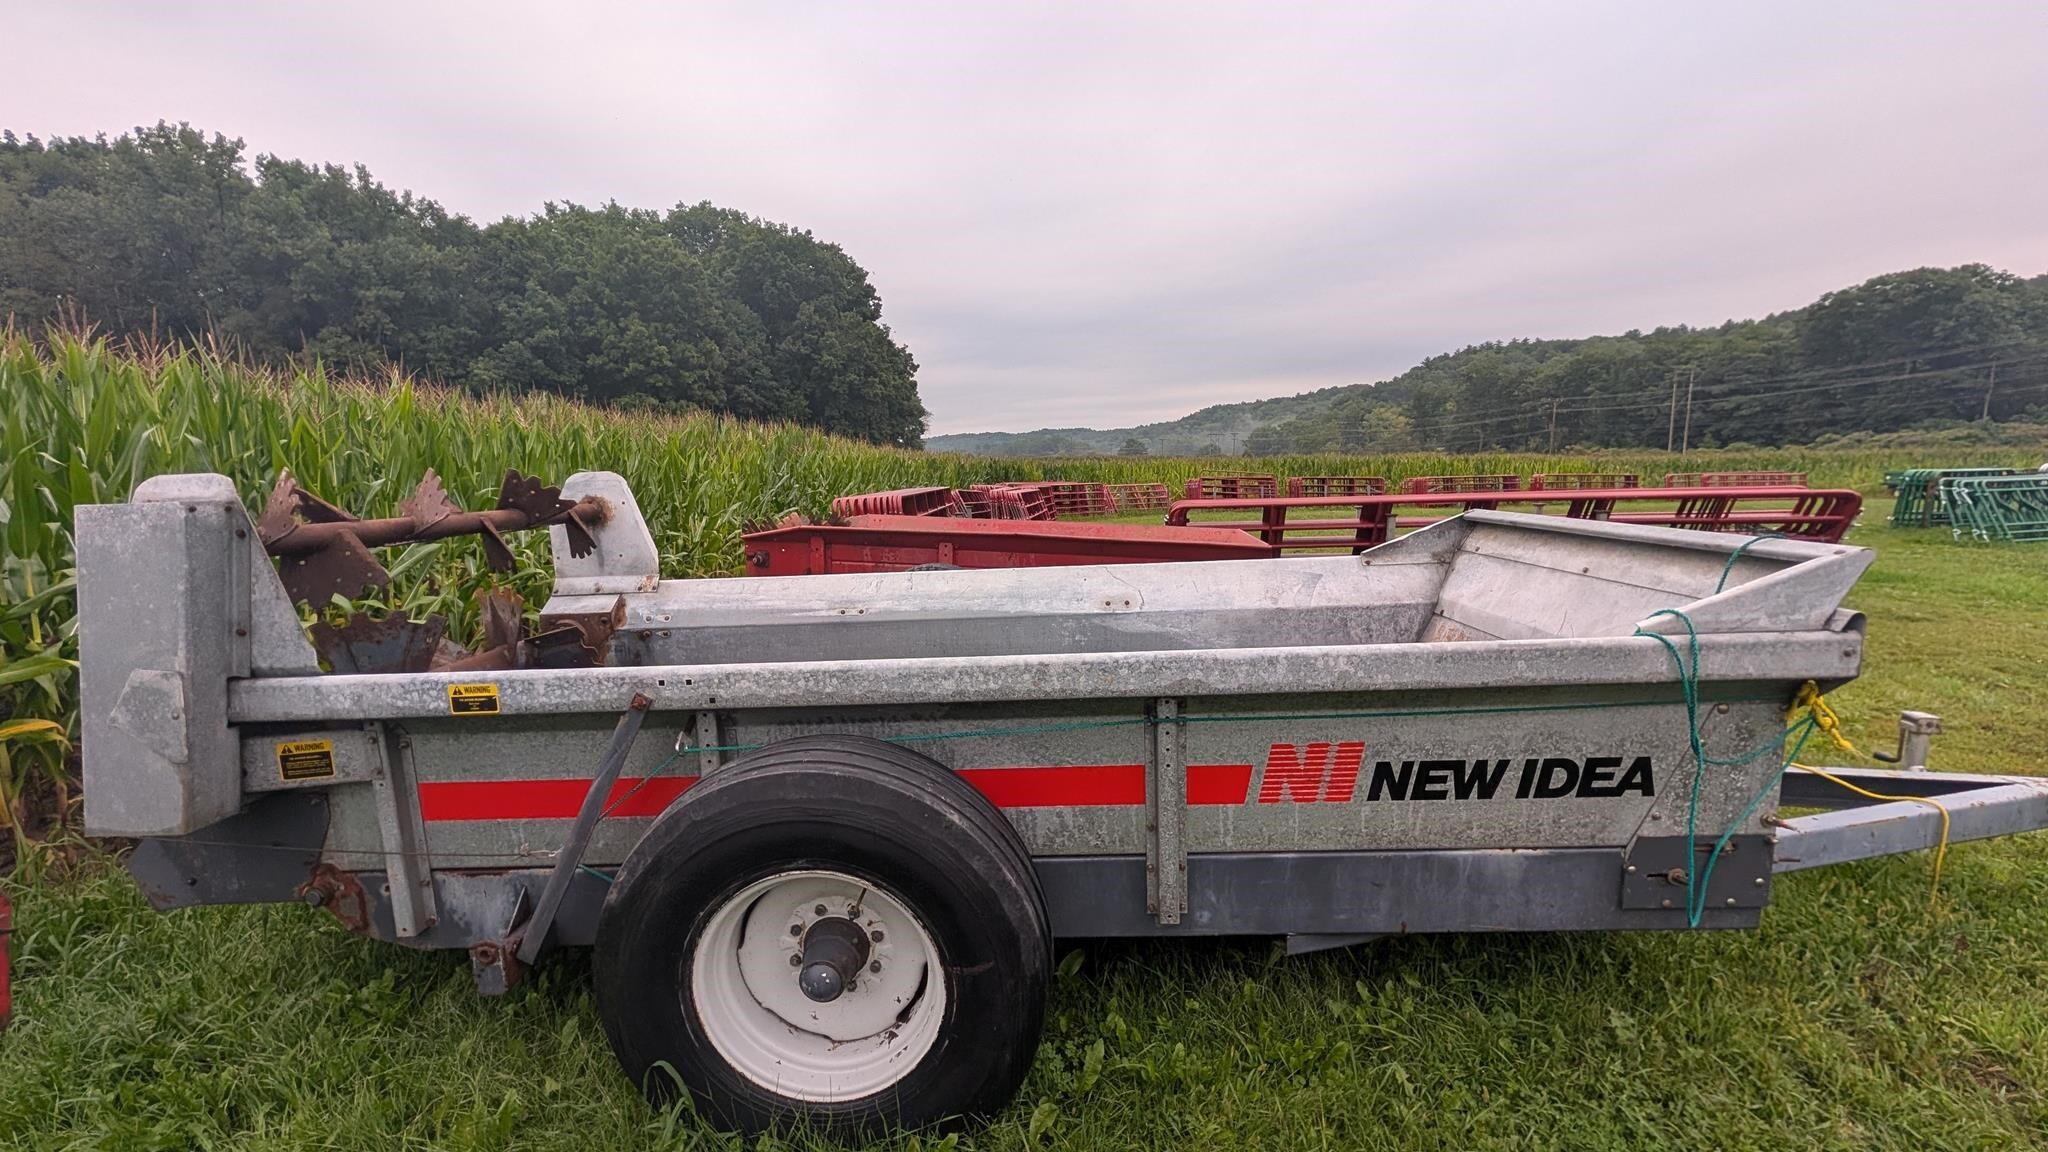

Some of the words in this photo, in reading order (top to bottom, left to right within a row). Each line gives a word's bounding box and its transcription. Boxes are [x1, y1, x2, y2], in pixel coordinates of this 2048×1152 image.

[463, 685, 491, 694] WARNING
[293, 742, 325, 752] WARNING
[1258, 741, 1366, 804] NI
[1366, 759, 1512, 801] NEW
[1515, 756, 1656, 799] IDEA
